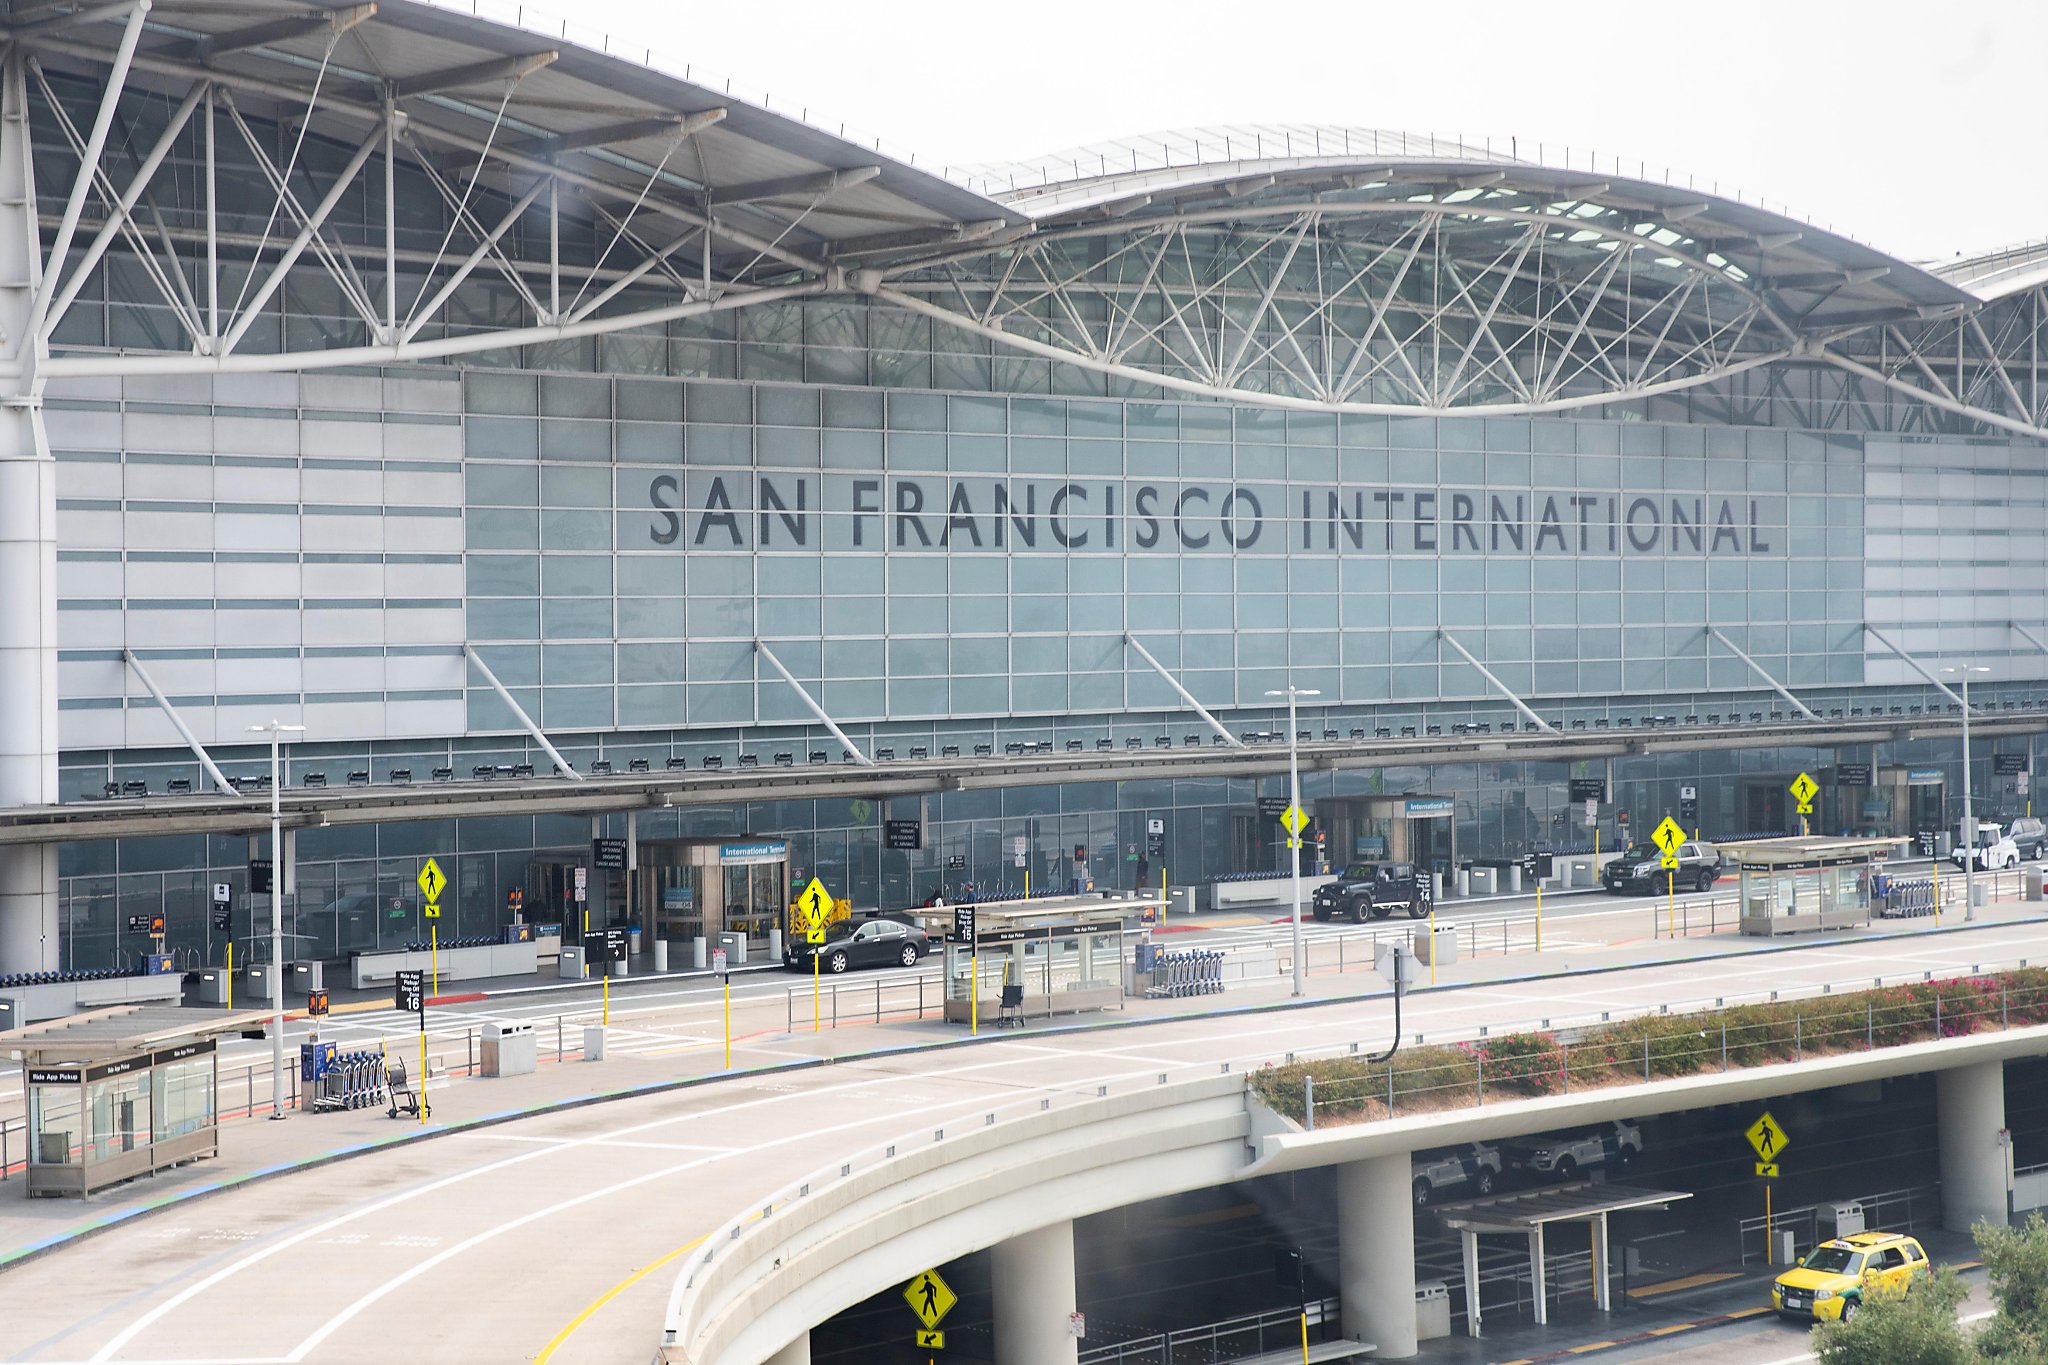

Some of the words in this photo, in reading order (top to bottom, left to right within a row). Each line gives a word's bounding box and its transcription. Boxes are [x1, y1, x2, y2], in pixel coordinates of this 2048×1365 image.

[649, 475, 806, 546] SAN
[852, 479, 1264, 549] FRANCISCO
[1302, 490, 1770, 554] INTERNATIONAL
[1410, 801, 1443, 810] International
[726, 846, 768, 856] International
[1420, 891, 1430, 902] 14
[961, 929, 972, 941] 15
[406, 997, 420, 1010] 16
[46, 1073, 58, 1082] App
